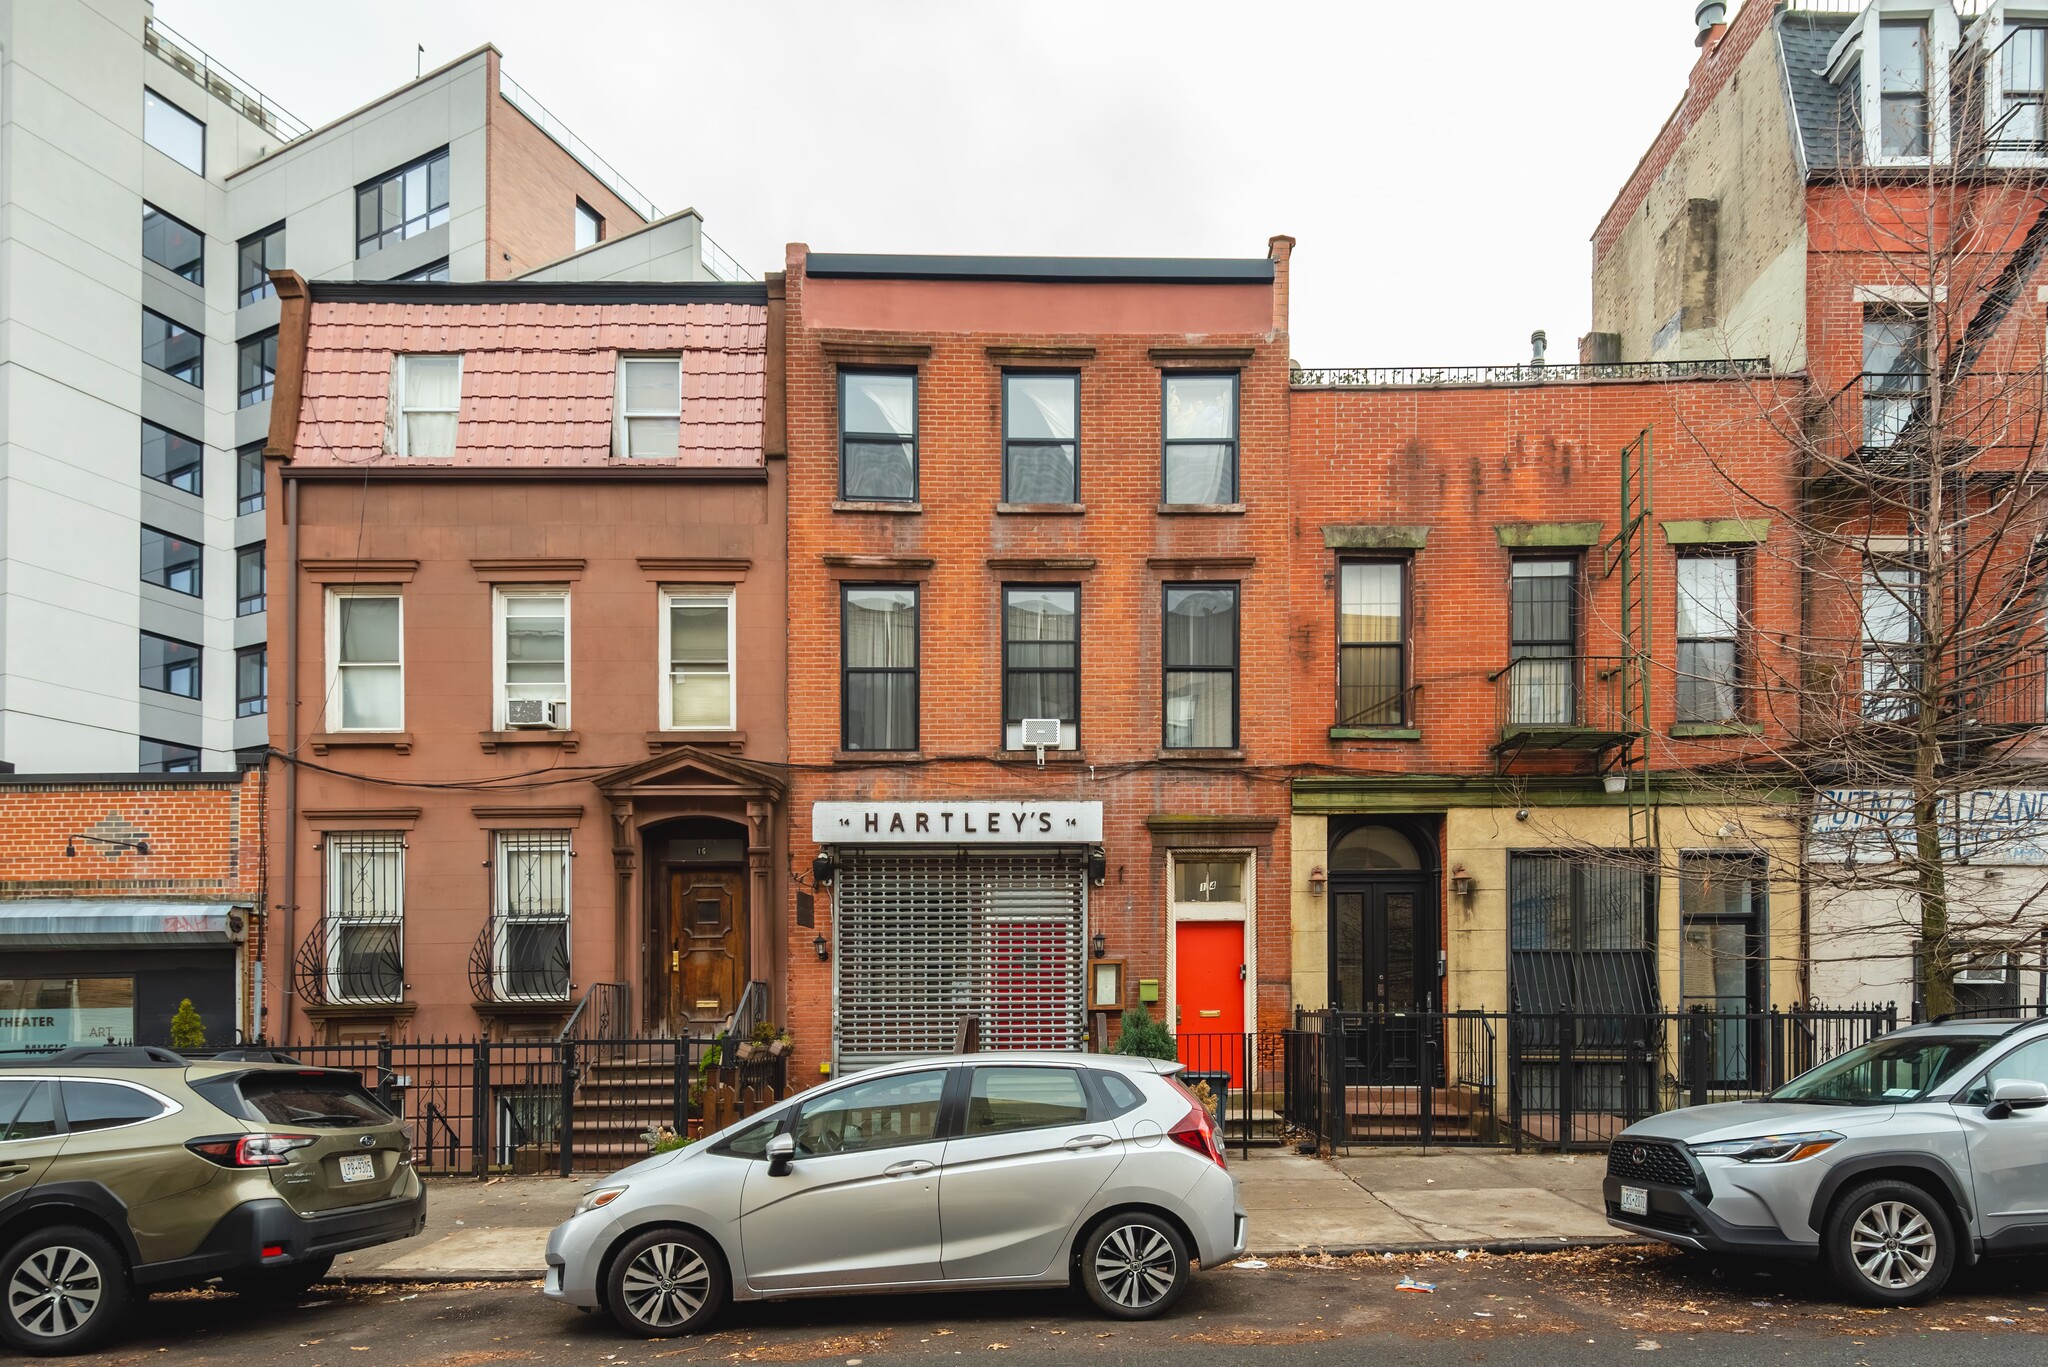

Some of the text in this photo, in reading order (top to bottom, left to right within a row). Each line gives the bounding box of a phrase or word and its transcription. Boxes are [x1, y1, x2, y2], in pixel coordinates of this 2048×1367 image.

[839, 812, 1077, 832] 14 HARTLEY'S 14
[697, 847, 706, 855] 16
[1201, 881, 1216, 891] 14
[89, 1027, 113, 1037] ART
